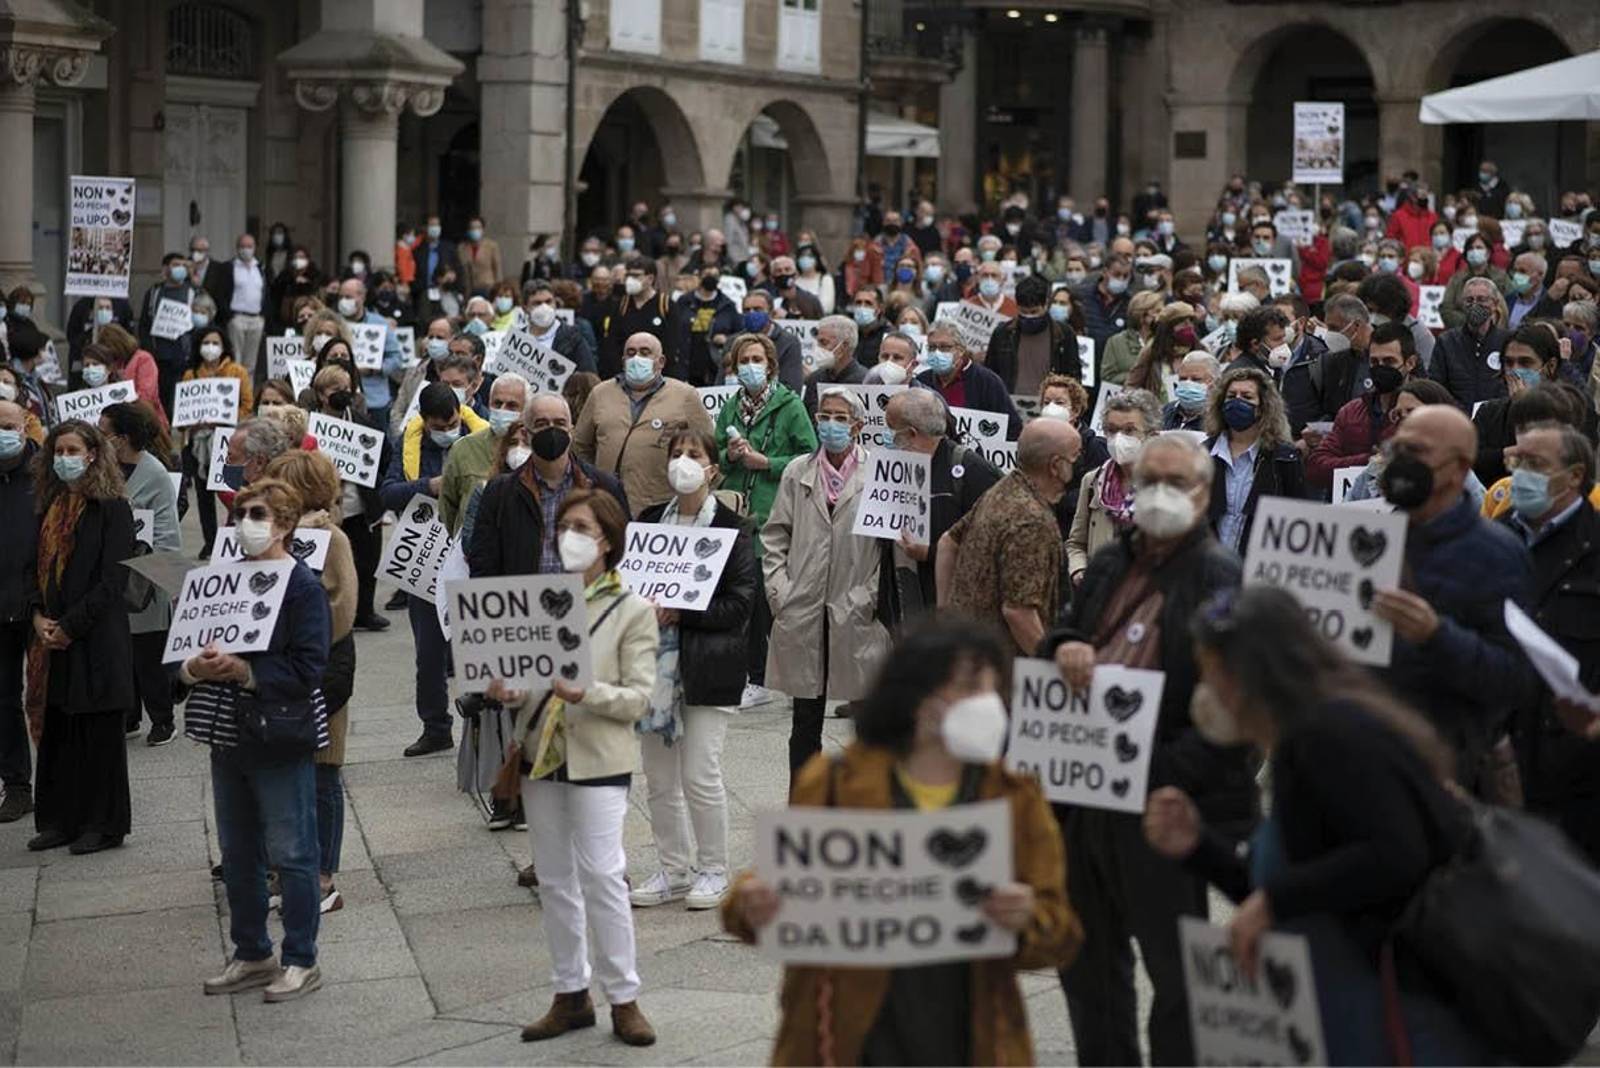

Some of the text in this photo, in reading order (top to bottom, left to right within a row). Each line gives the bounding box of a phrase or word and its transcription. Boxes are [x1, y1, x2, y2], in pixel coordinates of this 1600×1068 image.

[73, 185, 104, 200] NON
[73, 201, 111, 211] AO PECHE
[73, 214, 111, 226] DA UPO
[1552, 222, 1579, 236] NON
[66, 277, 127, 289] QUEREMOS UPO
[161, 302, 189, 318] NON
[960, 306, 995, 328] NON
[508, 333, 545, 365] NON
[503, 348, 516, 362] AO
[516, 358, 548, 380] PECHE
[180, 382, 212, 399] NON
[702, 393, 730, 410] ON
[64, 392, 104, 412] NON
[179, 396, 219, 408] AO PECHE
[178, 407, 219, 422] DA UPO
[315, 420, 354, 442] NON
[319, 438, 360, 458] O PECHE
[875, 459, 913, 486] NON
[869, 488, 918, 506] AO PECHE
[862, 513, 917, 534] DA UPO
[628, 530, 689, 557] NON
[1261, 515, 1338, 559] NON
[386, 527, 422, 580] NON
[407, 523, 442, 588] AO PECHE
[620, 558, 694, 574] AO PECHE
[186, 571, 242, 602] NON
[1254, 560, 1354, 595] AO PECHE
[639, 581, 681, 599] UPO
[179, 599, 250, 623] AO PECHE
[457, 589, 530, 620] NON
[172, 623, 240, 653] DA UPO
[461, 625, 552, 645] AO PECHE
[464, 653, 554, 680] DA UPO
[1018, 719, 1109, 749] AO PECHE
[1049, 757, 1105, 790] UPO
[774, 826, 906, 870] NON
[779, 875, 941, 903] AO PECHE
[776, 914, 943, 951] DA UPO
